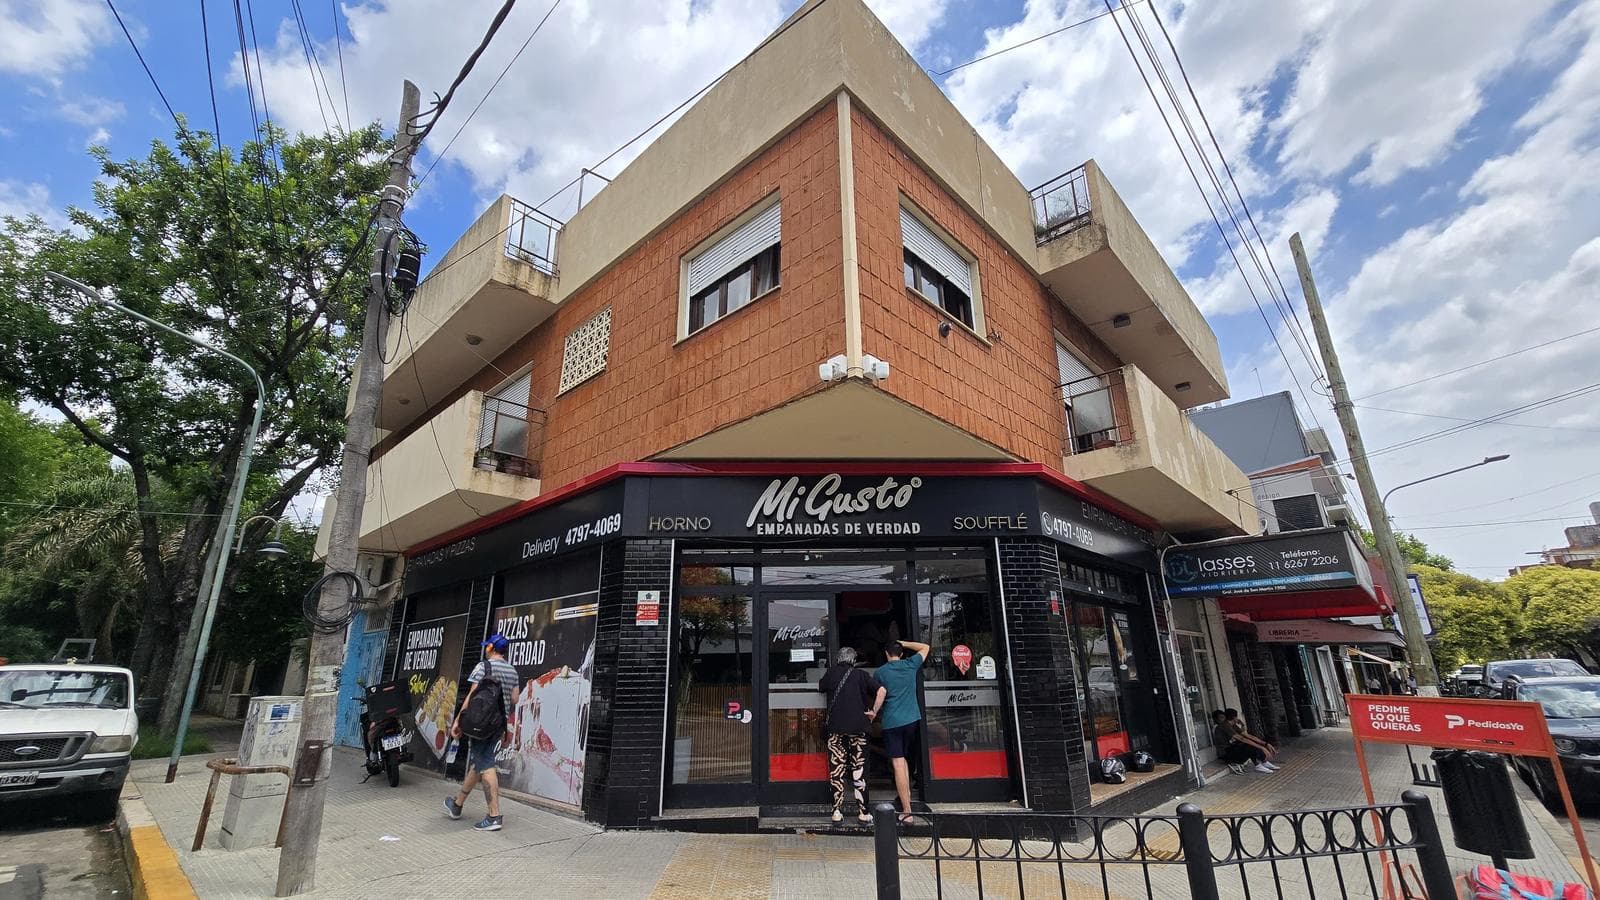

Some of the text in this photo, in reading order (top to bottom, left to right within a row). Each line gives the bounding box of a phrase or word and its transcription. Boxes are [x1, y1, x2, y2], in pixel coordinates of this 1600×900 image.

[747, 476, 805, 527] Mi
[649, 517, 711, 532] HORNO
[757, 522, 921, 536] EMPANADAS DE VERDAD
[954, 512, 1028, 530] SOUFFLÉ
[523, 513, 621, 558] Delivery 4797-4069
[1053, 517, 1093, 546] 4797-4069
[1269, 555, 1339, 570] 11 6267 2206
[497, 615, 529, 640] PIZZAS
[773, 626, 790, 643] Mi
[407, 626, 444, 650] EMPANADAS
[403, 649, 437, 671] DE VERDAD
[508, 640, 546, 666] VERDAD
[947, 692, 977, 704] Mi Gusto
[1368, 704, 1409, 714] PEDIME
[1370, 713, 1411, 723] LO QUE
[1372, 721, 1422, 732] QUIERAS
[1467, 719, 1524, 731] PedidosYa
